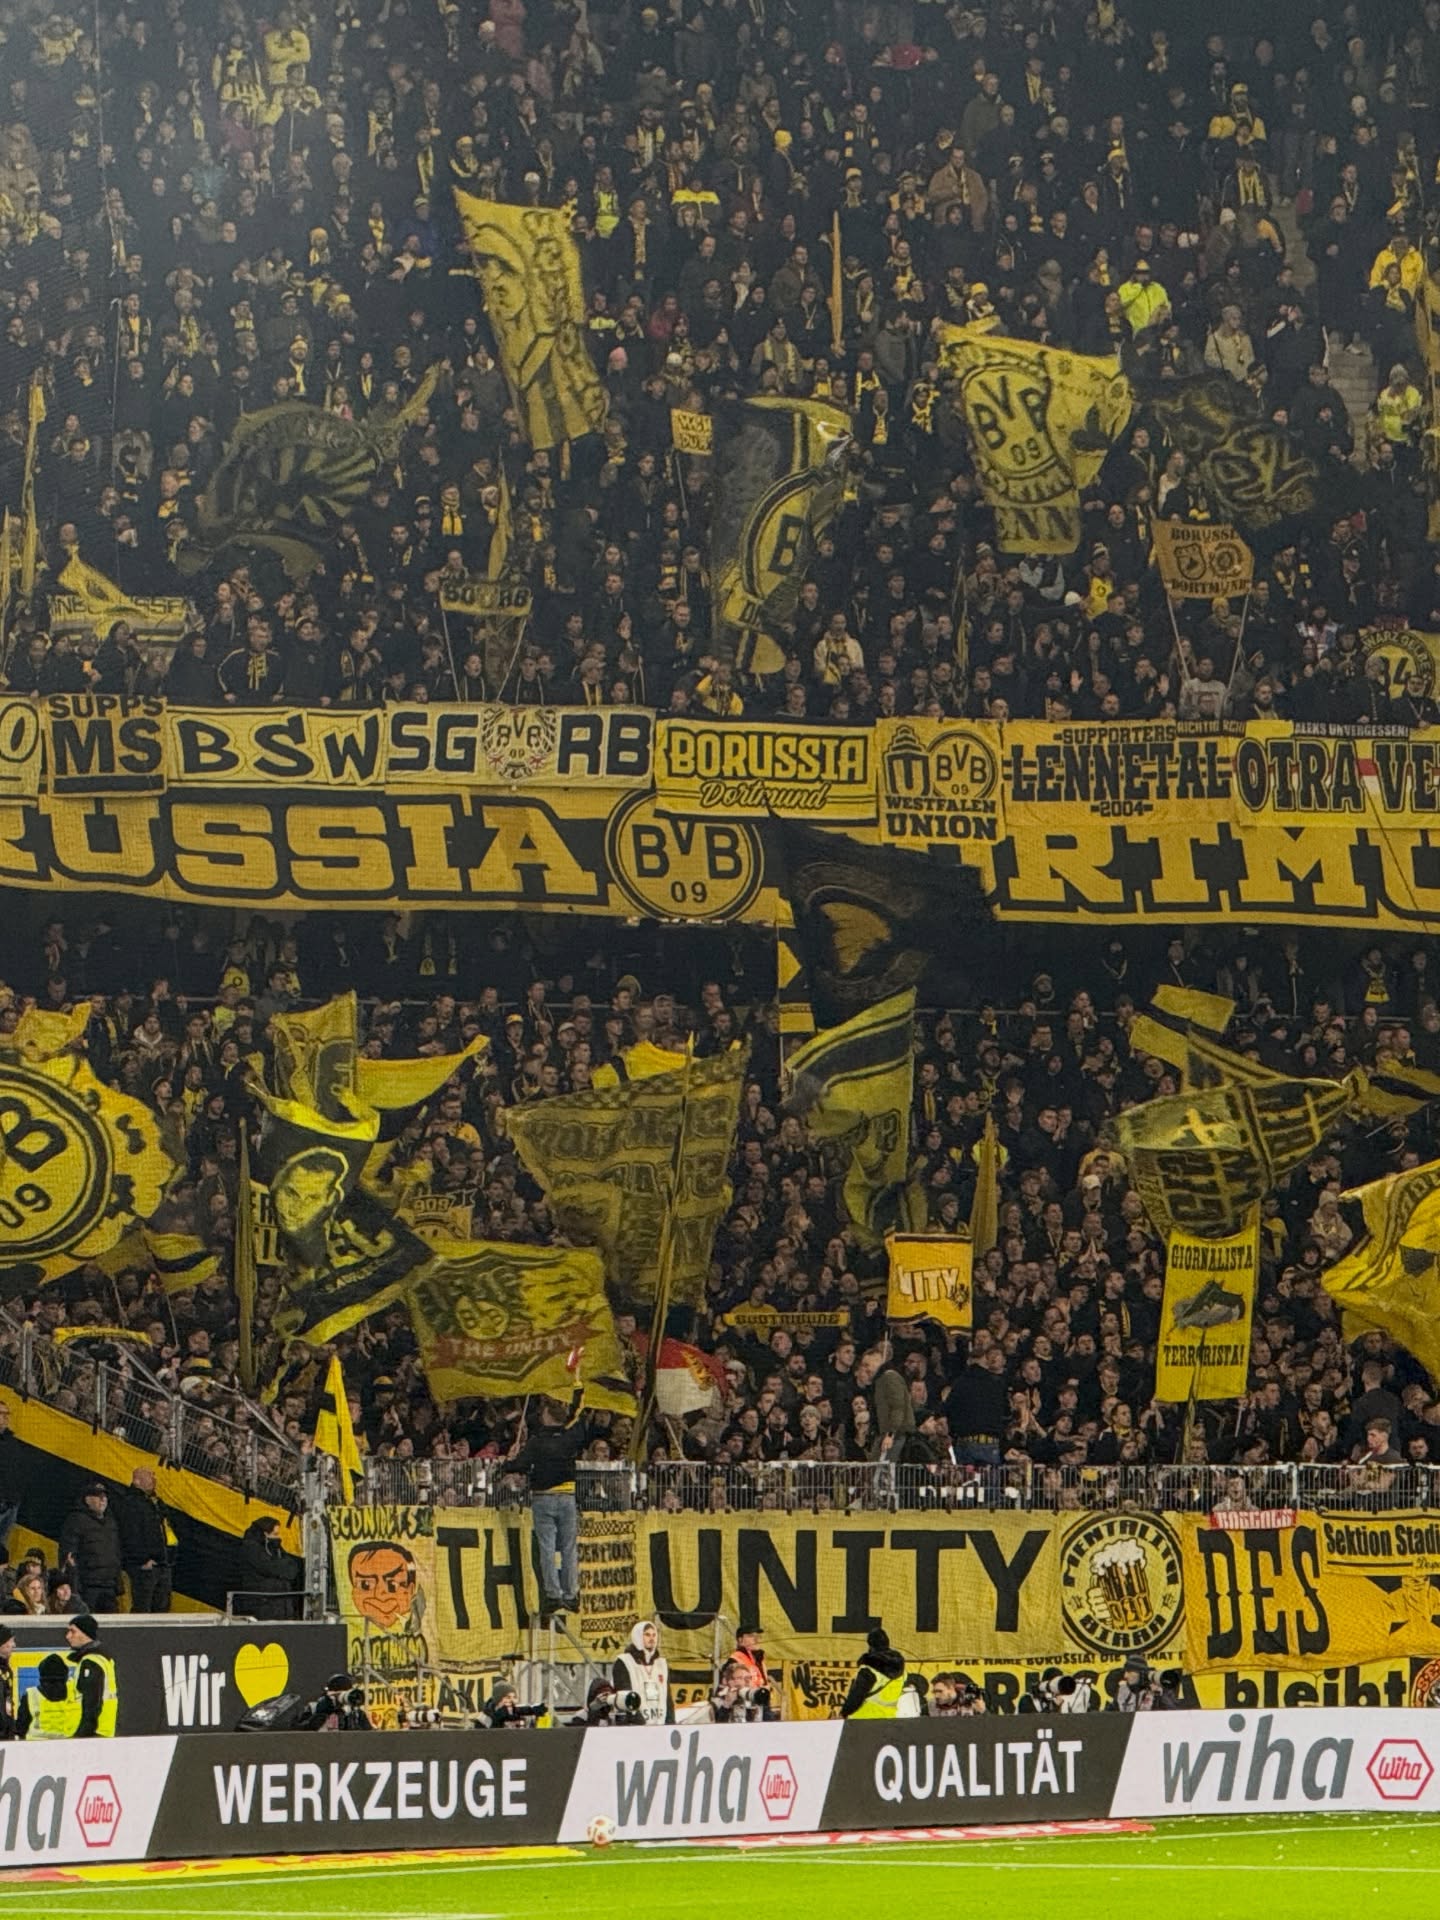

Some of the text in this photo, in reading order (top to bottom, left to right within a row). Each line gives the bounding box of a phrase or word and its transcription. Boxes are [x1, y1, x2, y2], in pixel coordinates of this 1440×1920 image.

[49, 694, 164, 718] SUPPS
[52, 718, 163, 774] MS
[388, 713, 479, 773] SG
[668, 727, 867, 783] BORUSSIA
[936, 743, 987, 785] BVB
[1011, 740, 1232, 802] LENNETAL
[699, 778, 832, 810] Dortmund
[951, 783, 969, 796] 09
[1237, 739, 1440, 813] OTRA VE
[885, 796, 996, 814] WESTFALEN
[886, 812, 998, 841] UNION
[632, 822, 743, 880] BVB
[670, 880, 708, 904] 09
[1171, 1244, 1255, 1272] GIORNALISTA
[1163, 1344, 1246, 1368] TERRORISTA!
[1323, 1522, 1394, 1556] Sektion
[649, 1528, 1049, 1633] UNITY
[1197, 1525, 1330, 1660] DES
[161, 1652, 226, 1728] Wir
[1224, 1665, 1409, 1708] bleibt
[616, 1729, 752, 1828] wiha
[873, 1728, 1083, 1804] QUALITÄT
[1163, 1713, 1355, 1804] wiha
[213, 1758, 528, 1825] WERKZEUGE
